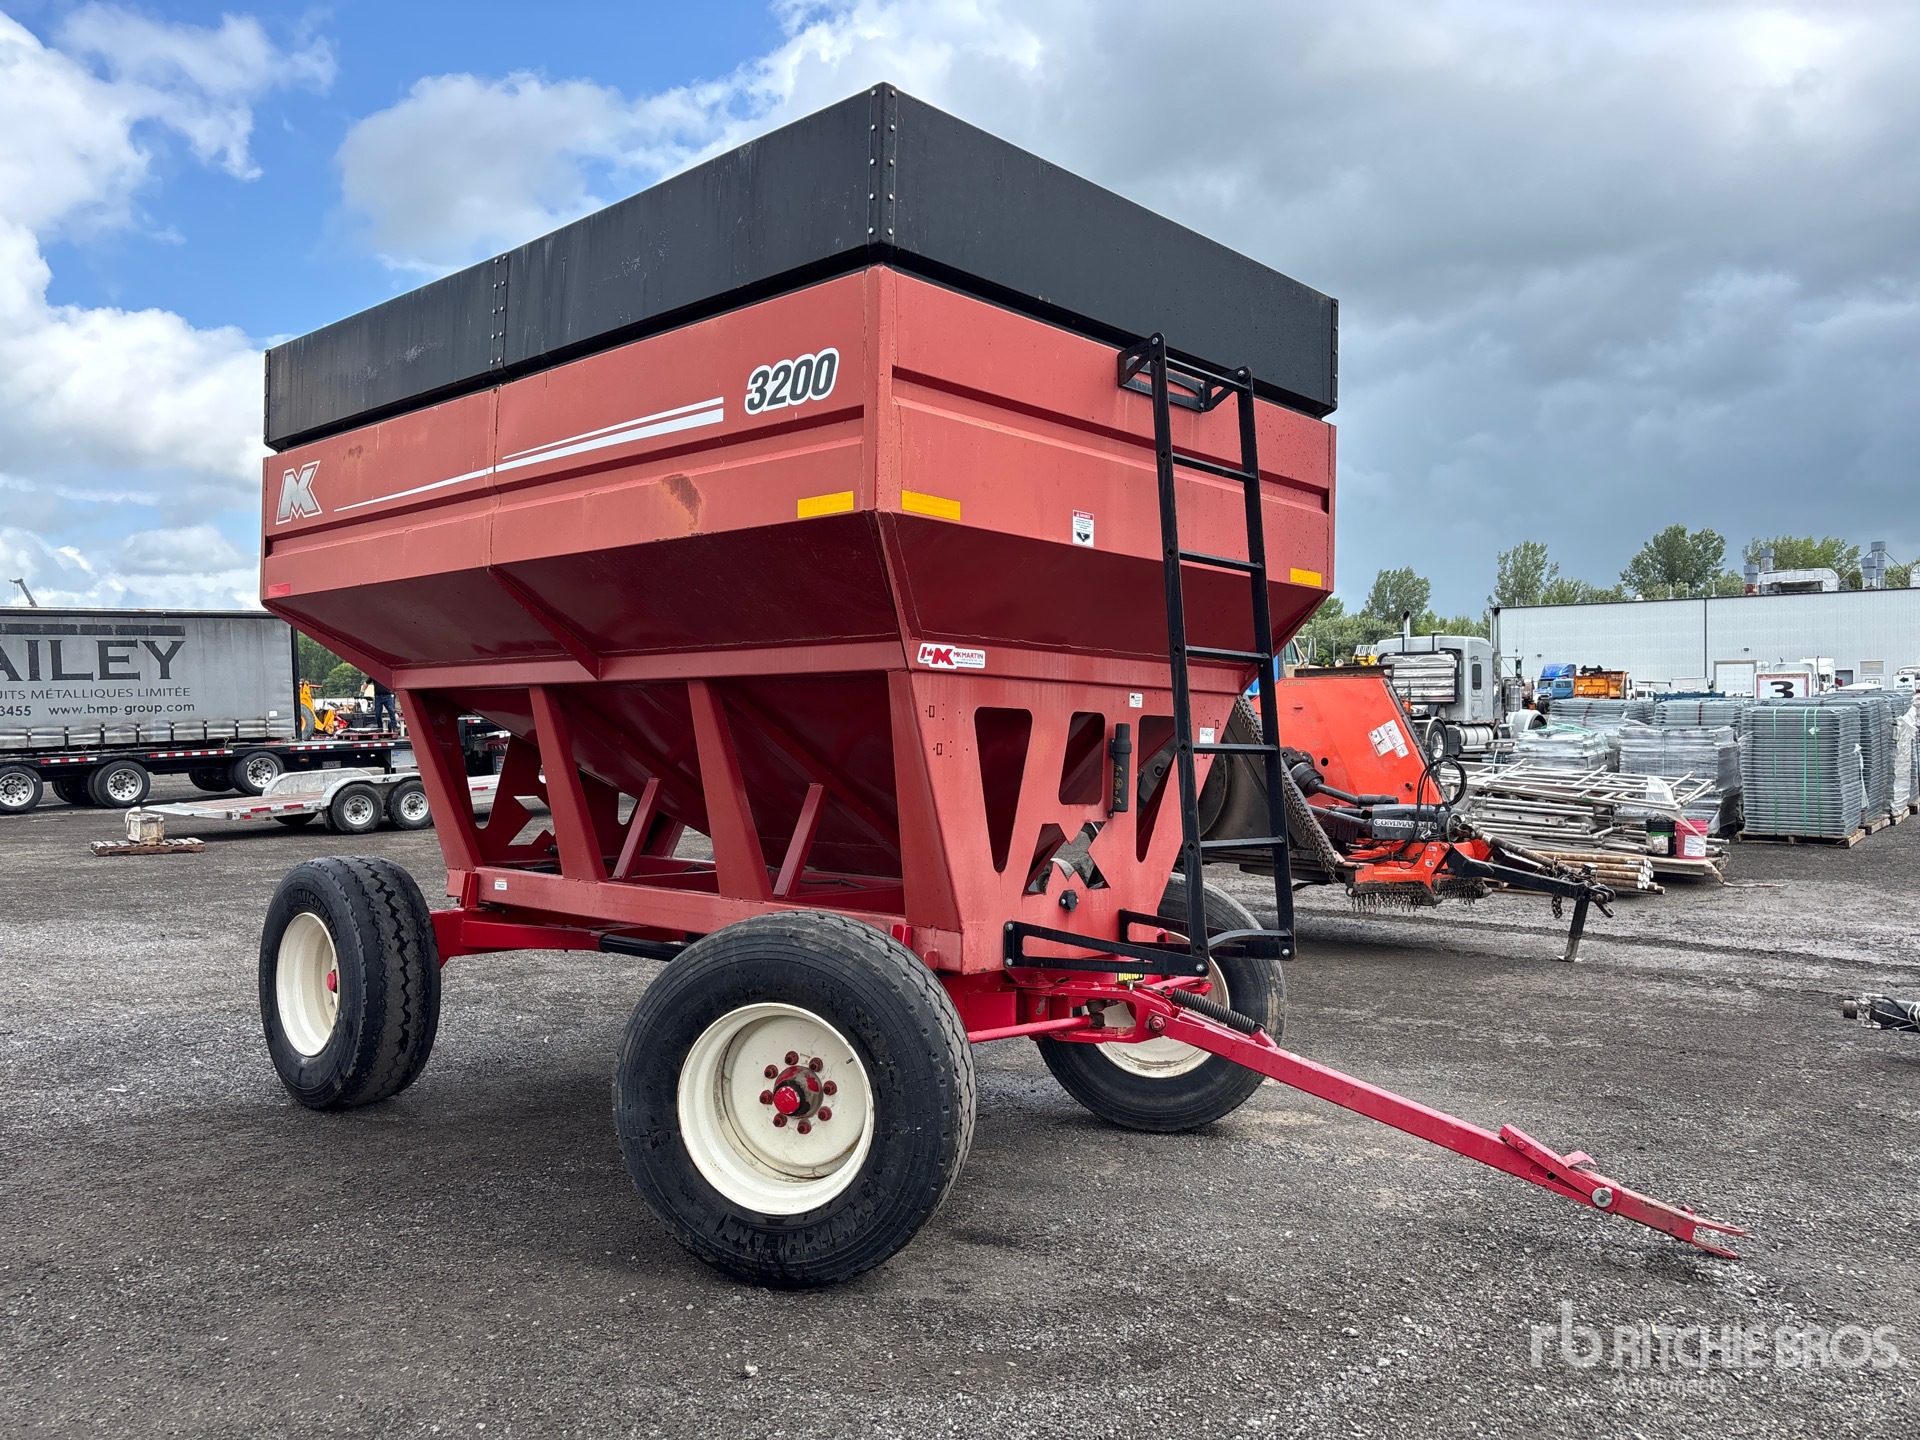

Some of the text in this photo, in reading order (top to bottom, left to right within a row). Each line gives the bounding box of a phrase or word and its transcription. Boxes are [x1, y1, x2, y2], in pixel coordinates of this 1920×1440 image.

[745, 348, 839, 415] 3200
[31, 687, 134, 700] MÉTALLIQUES
[137, 686, 191, 697] LIMITÉE
[1770, 681, 1794, 698] 3
[0, 702, 195, 716] 3455 www.bmp-group.com
